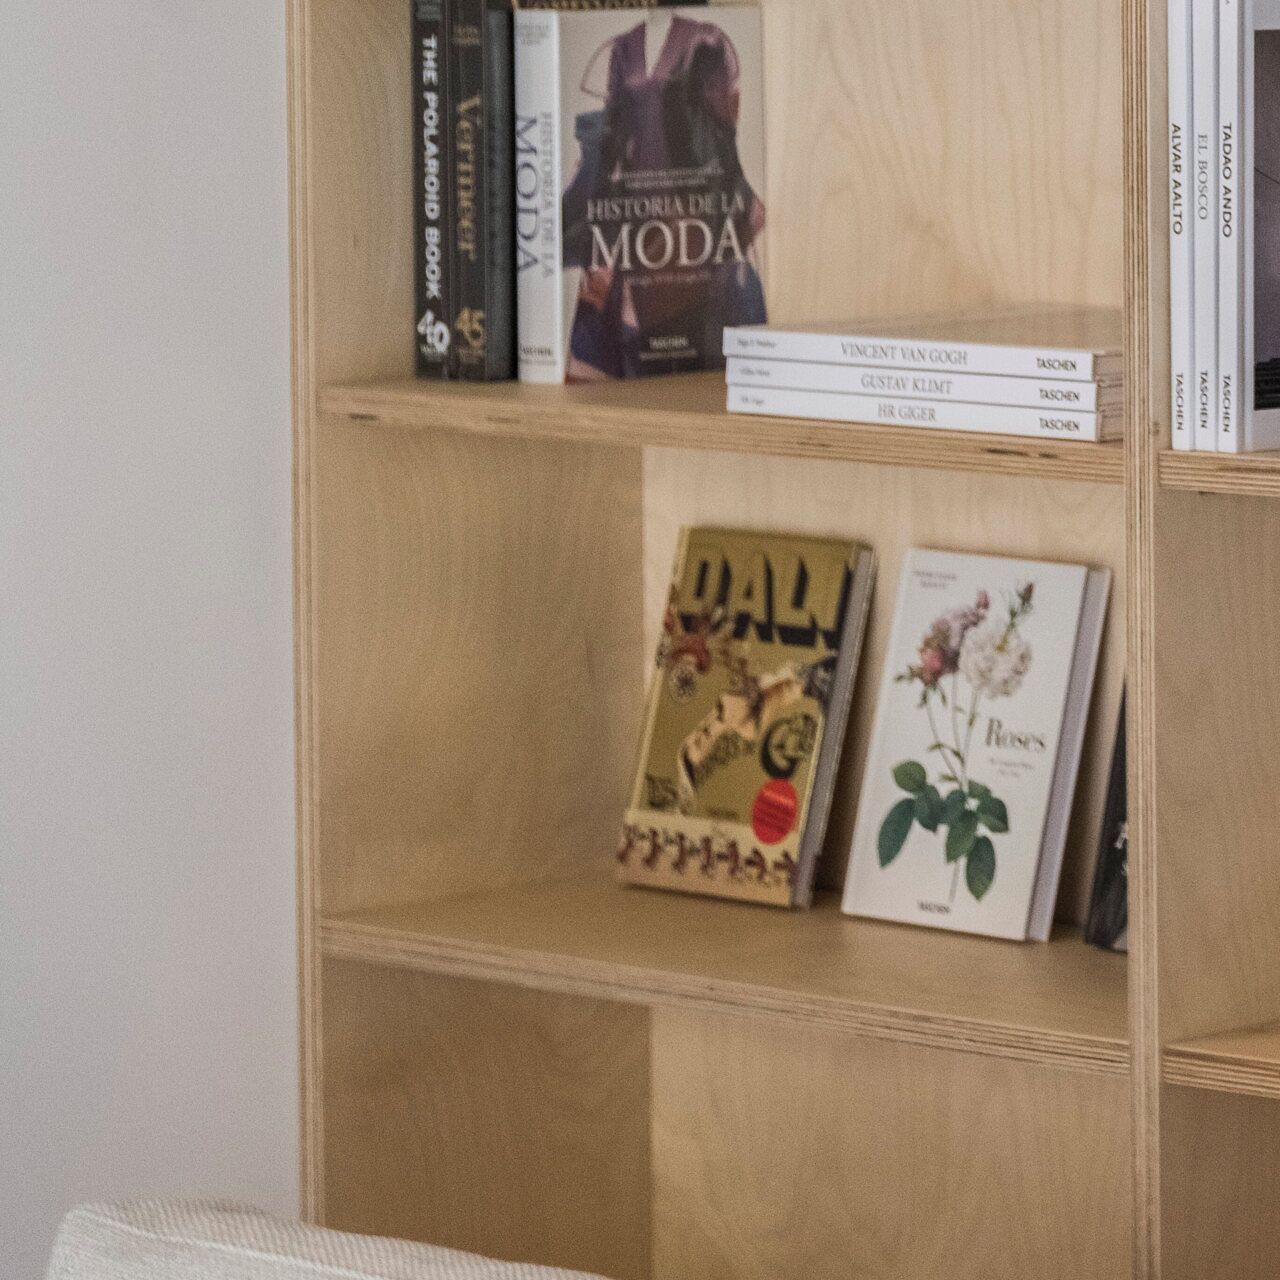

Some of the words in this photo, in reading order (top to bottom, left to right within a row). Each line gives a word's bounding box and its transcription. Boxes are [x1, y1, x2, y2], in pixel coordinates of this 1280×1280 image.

[422, 35, 438, 86] THE
[422, 91, 441, 220] POLAROID
[1172, 123, 1182, 173] ALVAR
[1198, 134, 1208, 154] EL
[1223, 122, 1232, 180] TADAO
[516, 116, 539, 273] MODA
[587, 194, 685, 220] HISTORIA
[1173, 179, 1183, 235] AALTO
[1198, 160, 1208, 220] BOSCO
[1223, 185, 1232, 238] ANDO
[424, 226, 442, 300] BOOK
[590, 217, 746, 270] MODA
[841, 342, 897, 361] VINCENT
[900, 347, 926, 362] VAN
[929, 348, 968, 366] GOGH
[1036, 358, 1077, 371] TASCHEN
[861, 374, 908, 392] GUSTAV
[912, 377, 953, 395] KLIMT
[1039, 388, 1080, 402] TASCHEN
[1176, 372, 1184, 431] TASCHEN
[1200, 370, 1208, 429] TASCHEN
[1223, 375, 1231, 433] TASCHEN
[877, 403, 895, 419] HR
[898, 404, 936, 422] GIGER
[1039, 418, 1080, 432] TASCHEN
